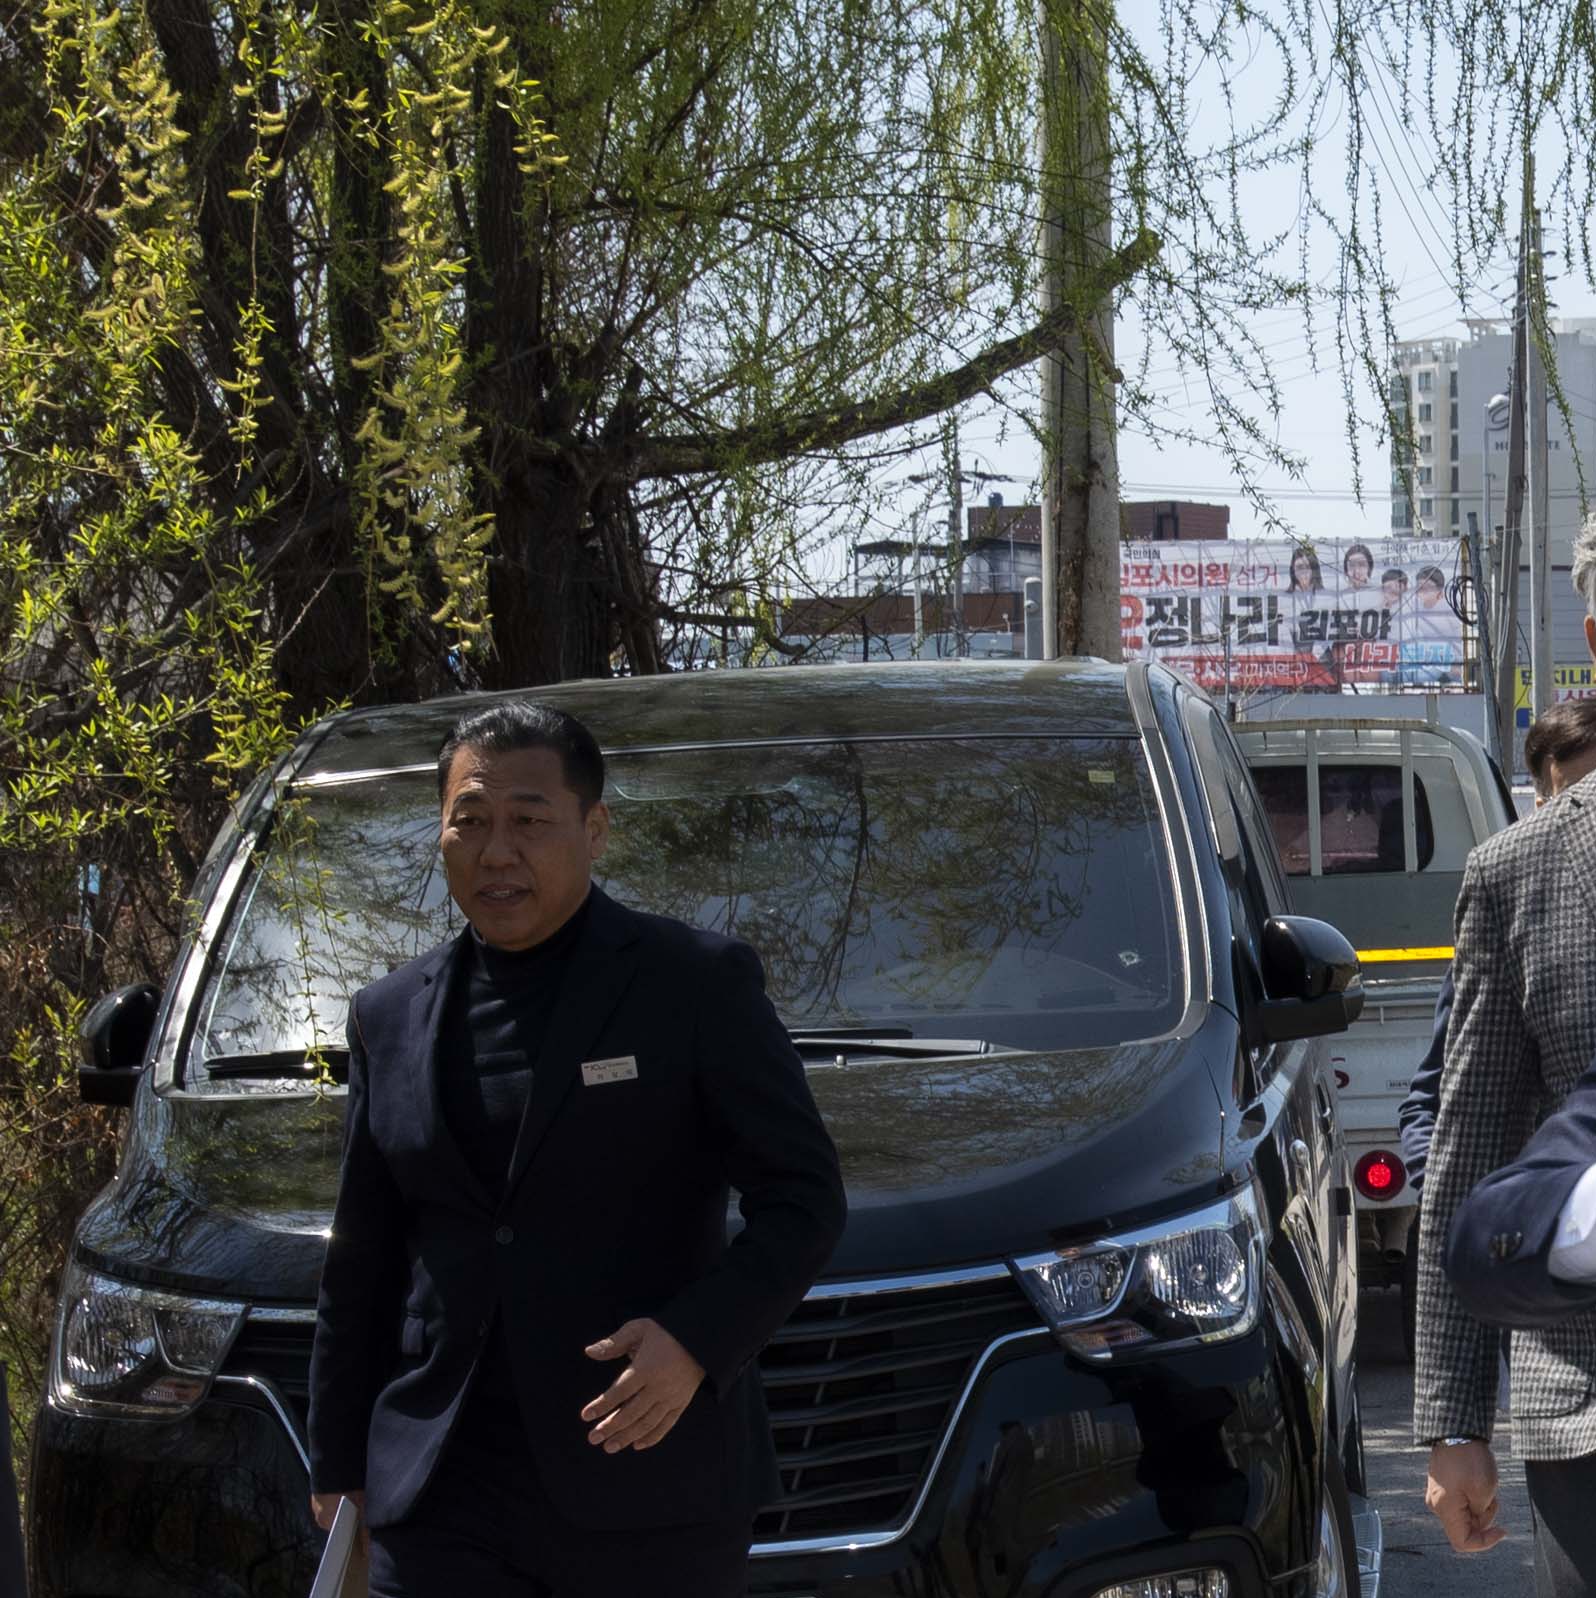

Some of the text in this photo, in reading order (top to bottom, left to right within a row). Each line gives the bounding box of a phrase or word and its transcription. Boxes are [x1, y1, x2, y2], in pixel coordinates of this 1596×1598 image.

[1236, 562, 1279, 586] 선거
[1145, 594, 1284, 648] 정나라
[1298, 608, 1393, 641] 김포야
